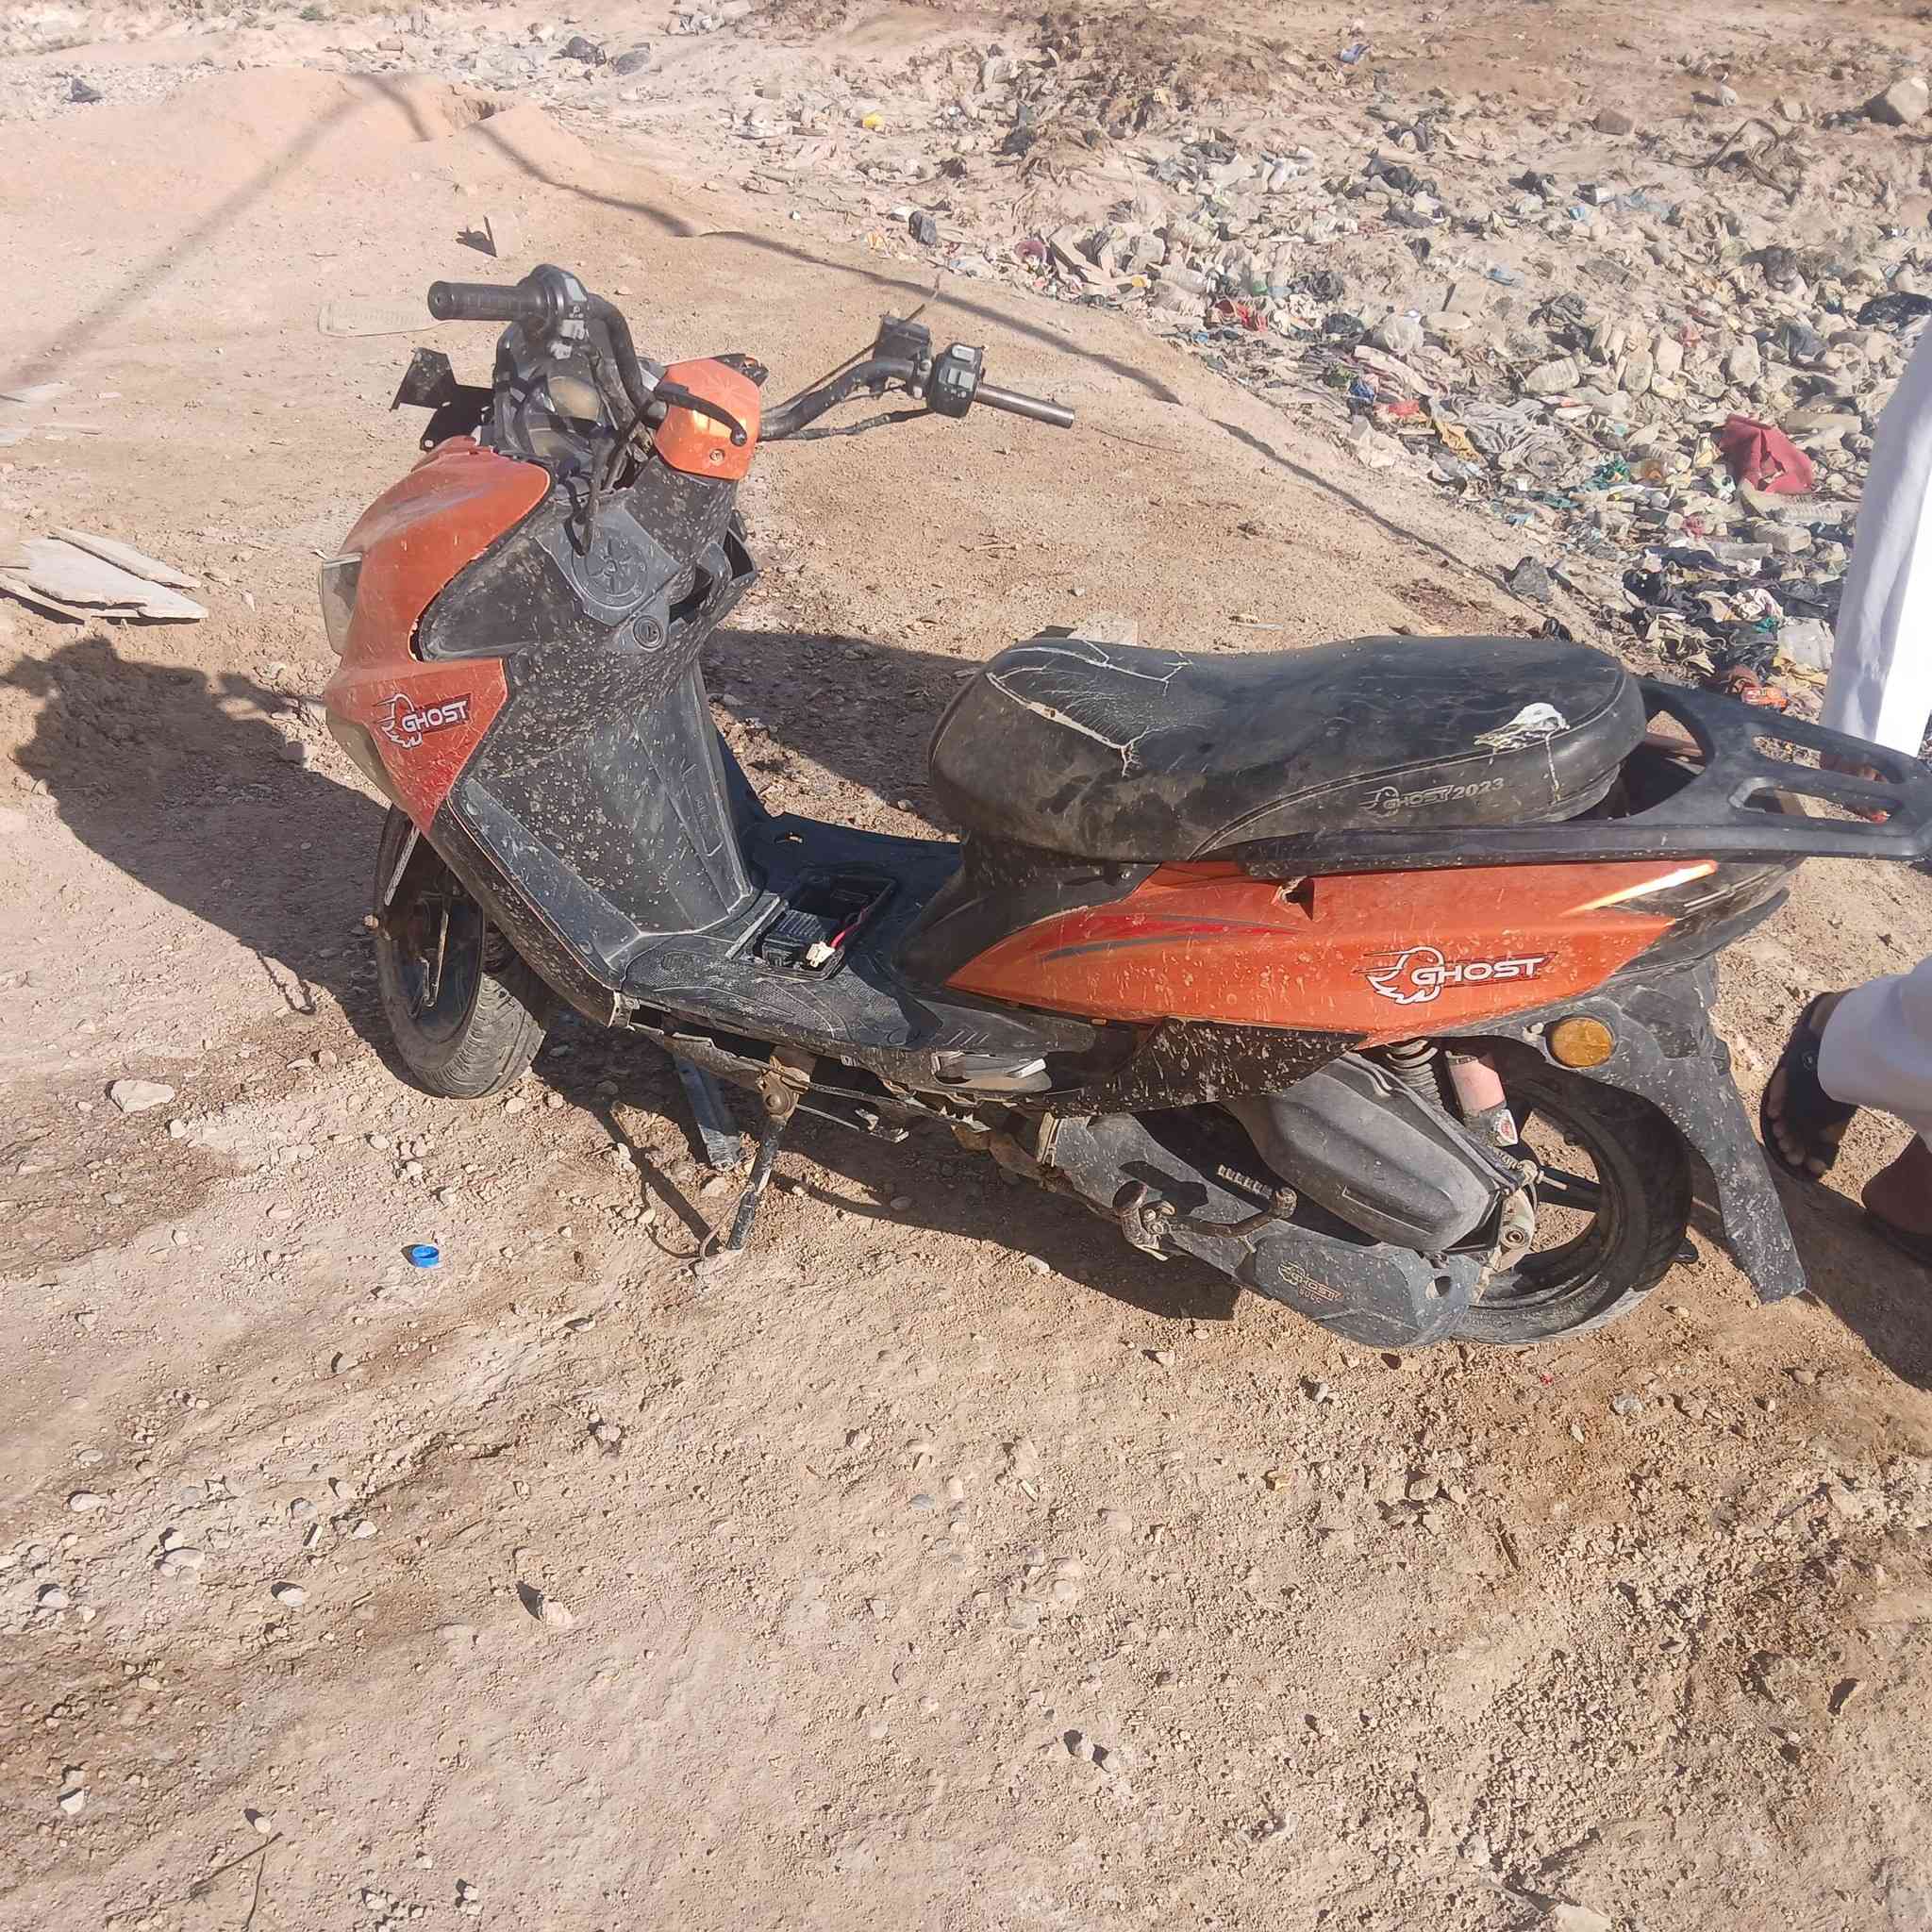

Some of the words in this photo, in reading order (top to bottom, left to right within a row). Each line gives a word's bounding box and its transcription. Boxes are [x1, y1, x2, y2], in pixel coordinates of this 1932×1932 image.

[402, 700, 468, 733] GHOST
[1383, 787, 1451, 810] GHOST
[1452, 777, 1505, 800] 2023
[1411, 957, 1544, 986] GHOST
